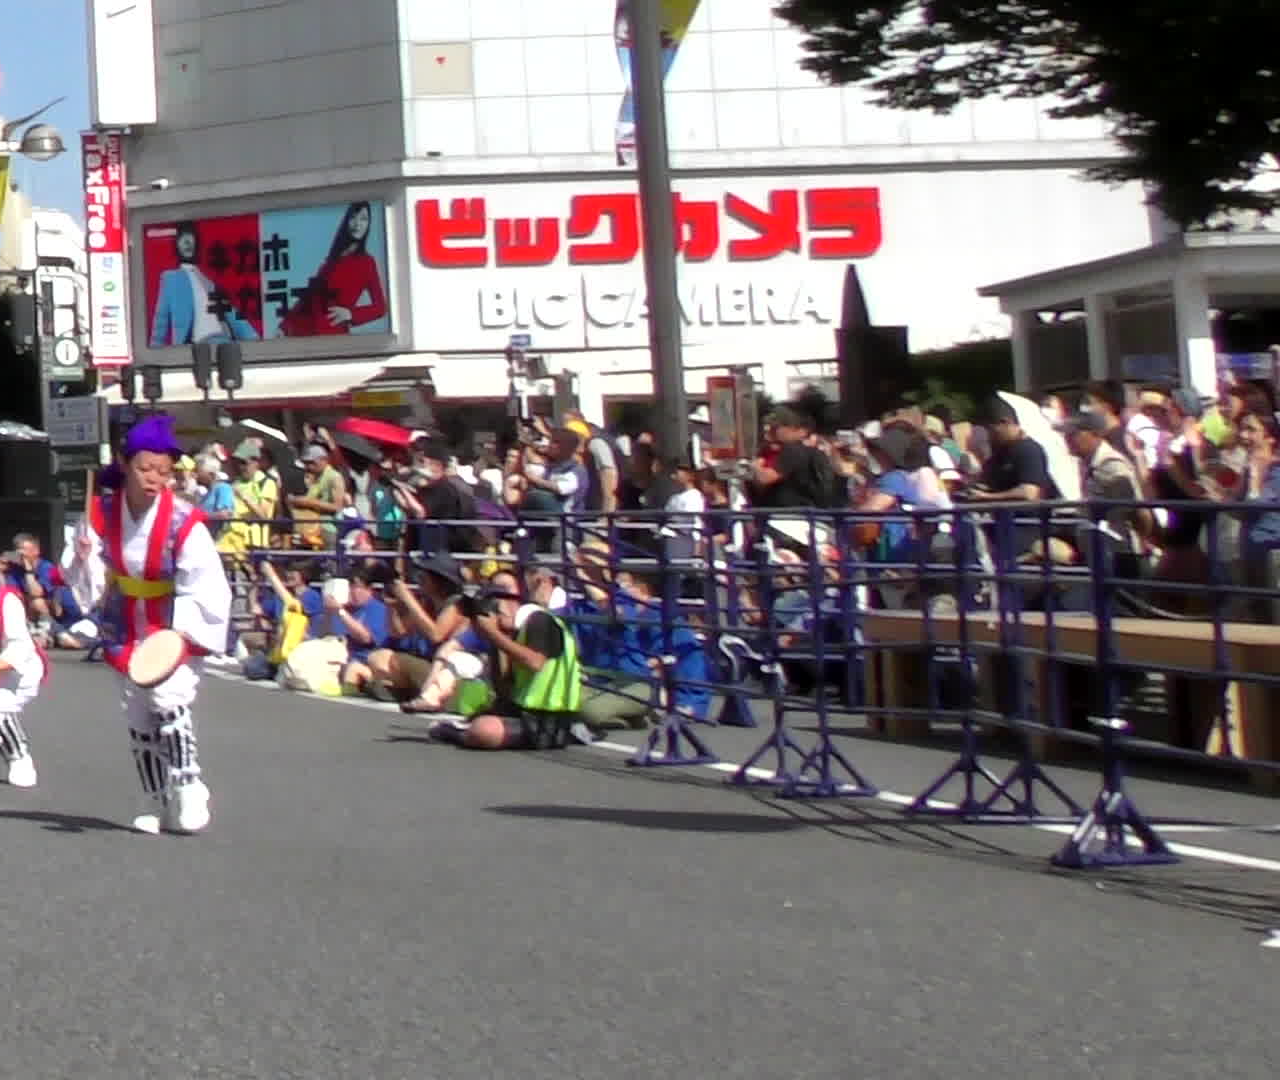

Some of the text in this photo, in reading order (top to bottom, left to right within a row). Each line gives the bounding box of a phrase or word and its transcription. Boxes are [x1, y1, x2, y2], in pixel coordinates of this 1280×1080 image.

[414, 187, 882, 268] ビックカメラ
[478, 287, 571, 328] BIC
